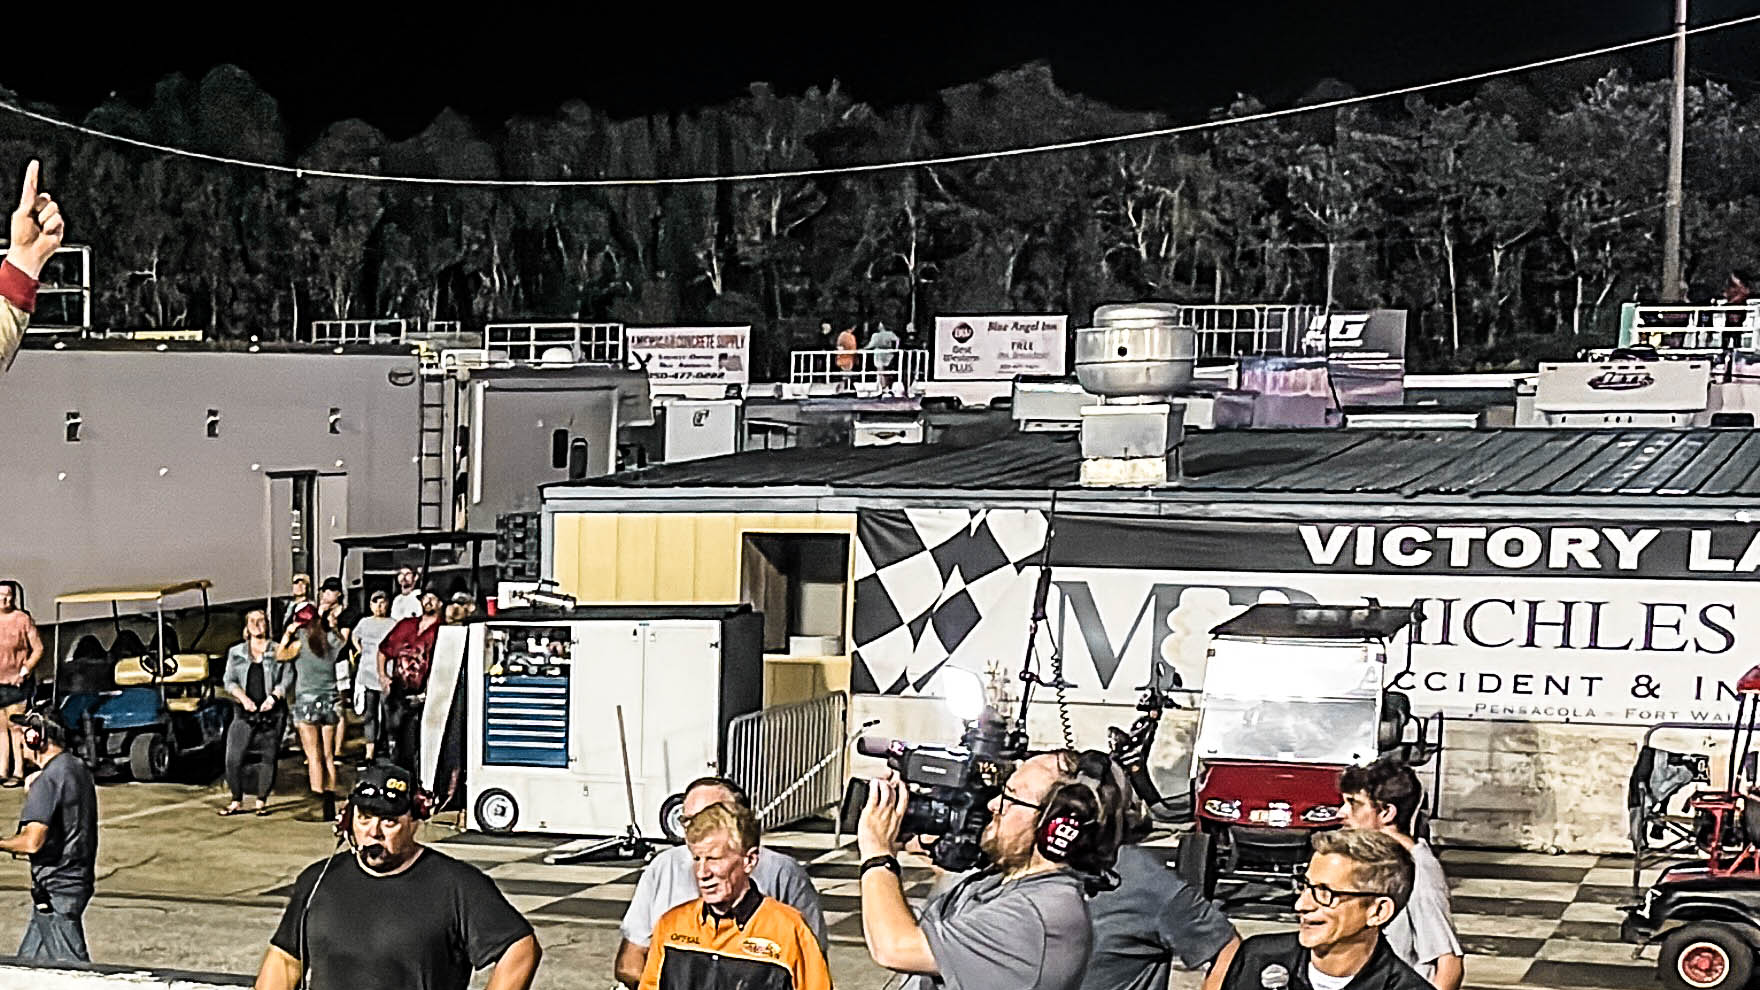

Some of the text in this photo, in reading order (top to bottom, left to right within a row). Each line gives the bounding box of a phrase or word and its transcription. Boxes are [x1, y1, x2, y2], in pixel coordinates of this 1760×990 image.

[1011, 321, 1040, 333] Angel
[1298, 525, 1661, 571] VICTORY
[1631, 674, 1661, 699] &
[1474, 702, 1597, 719] PENSACOLA
[1624, 708, 1678, 721] FORT
